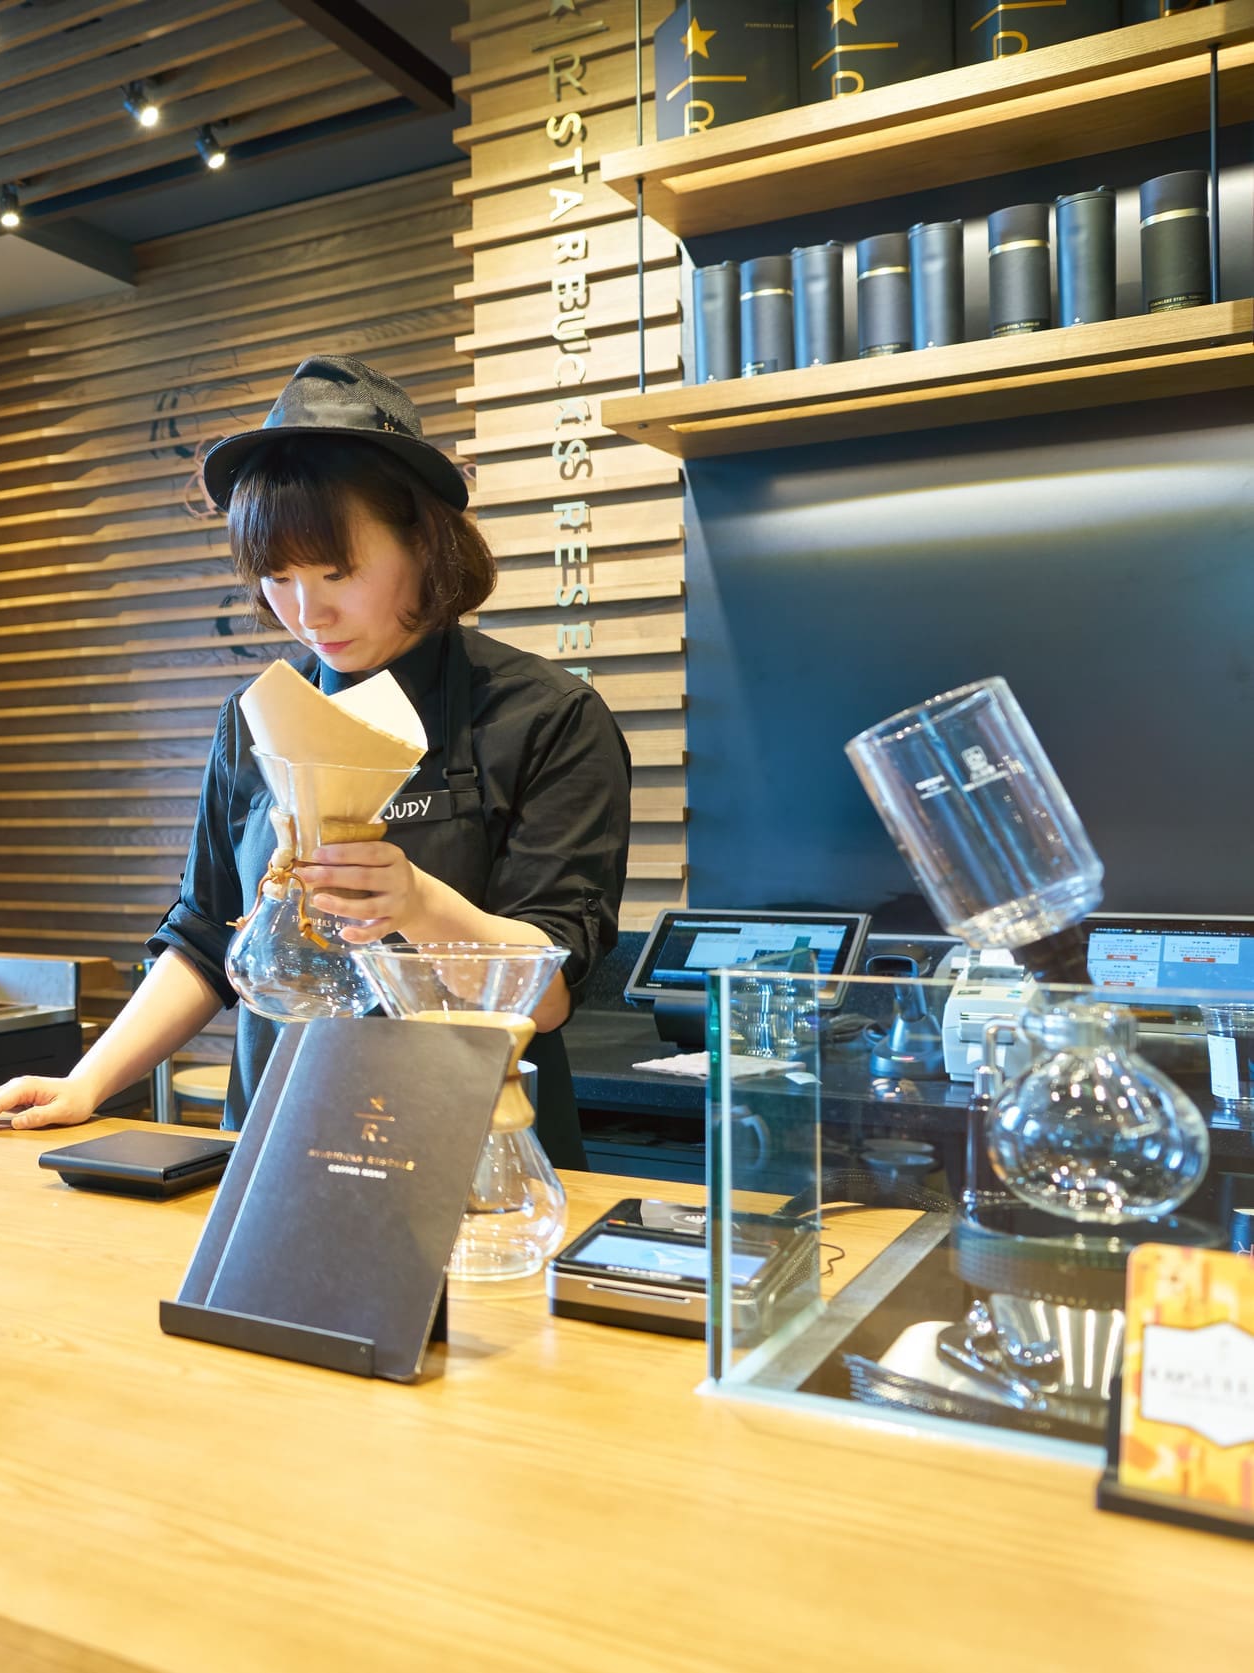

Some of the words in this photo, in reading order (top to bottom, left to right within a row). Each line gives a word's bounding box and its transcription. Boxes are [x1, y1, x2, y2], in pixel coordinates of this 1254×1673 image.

[548, 53, 581, 95] R
[546, 111, 587, 462] STARBUCKS
[384, 796, 432, 820] JUDY
